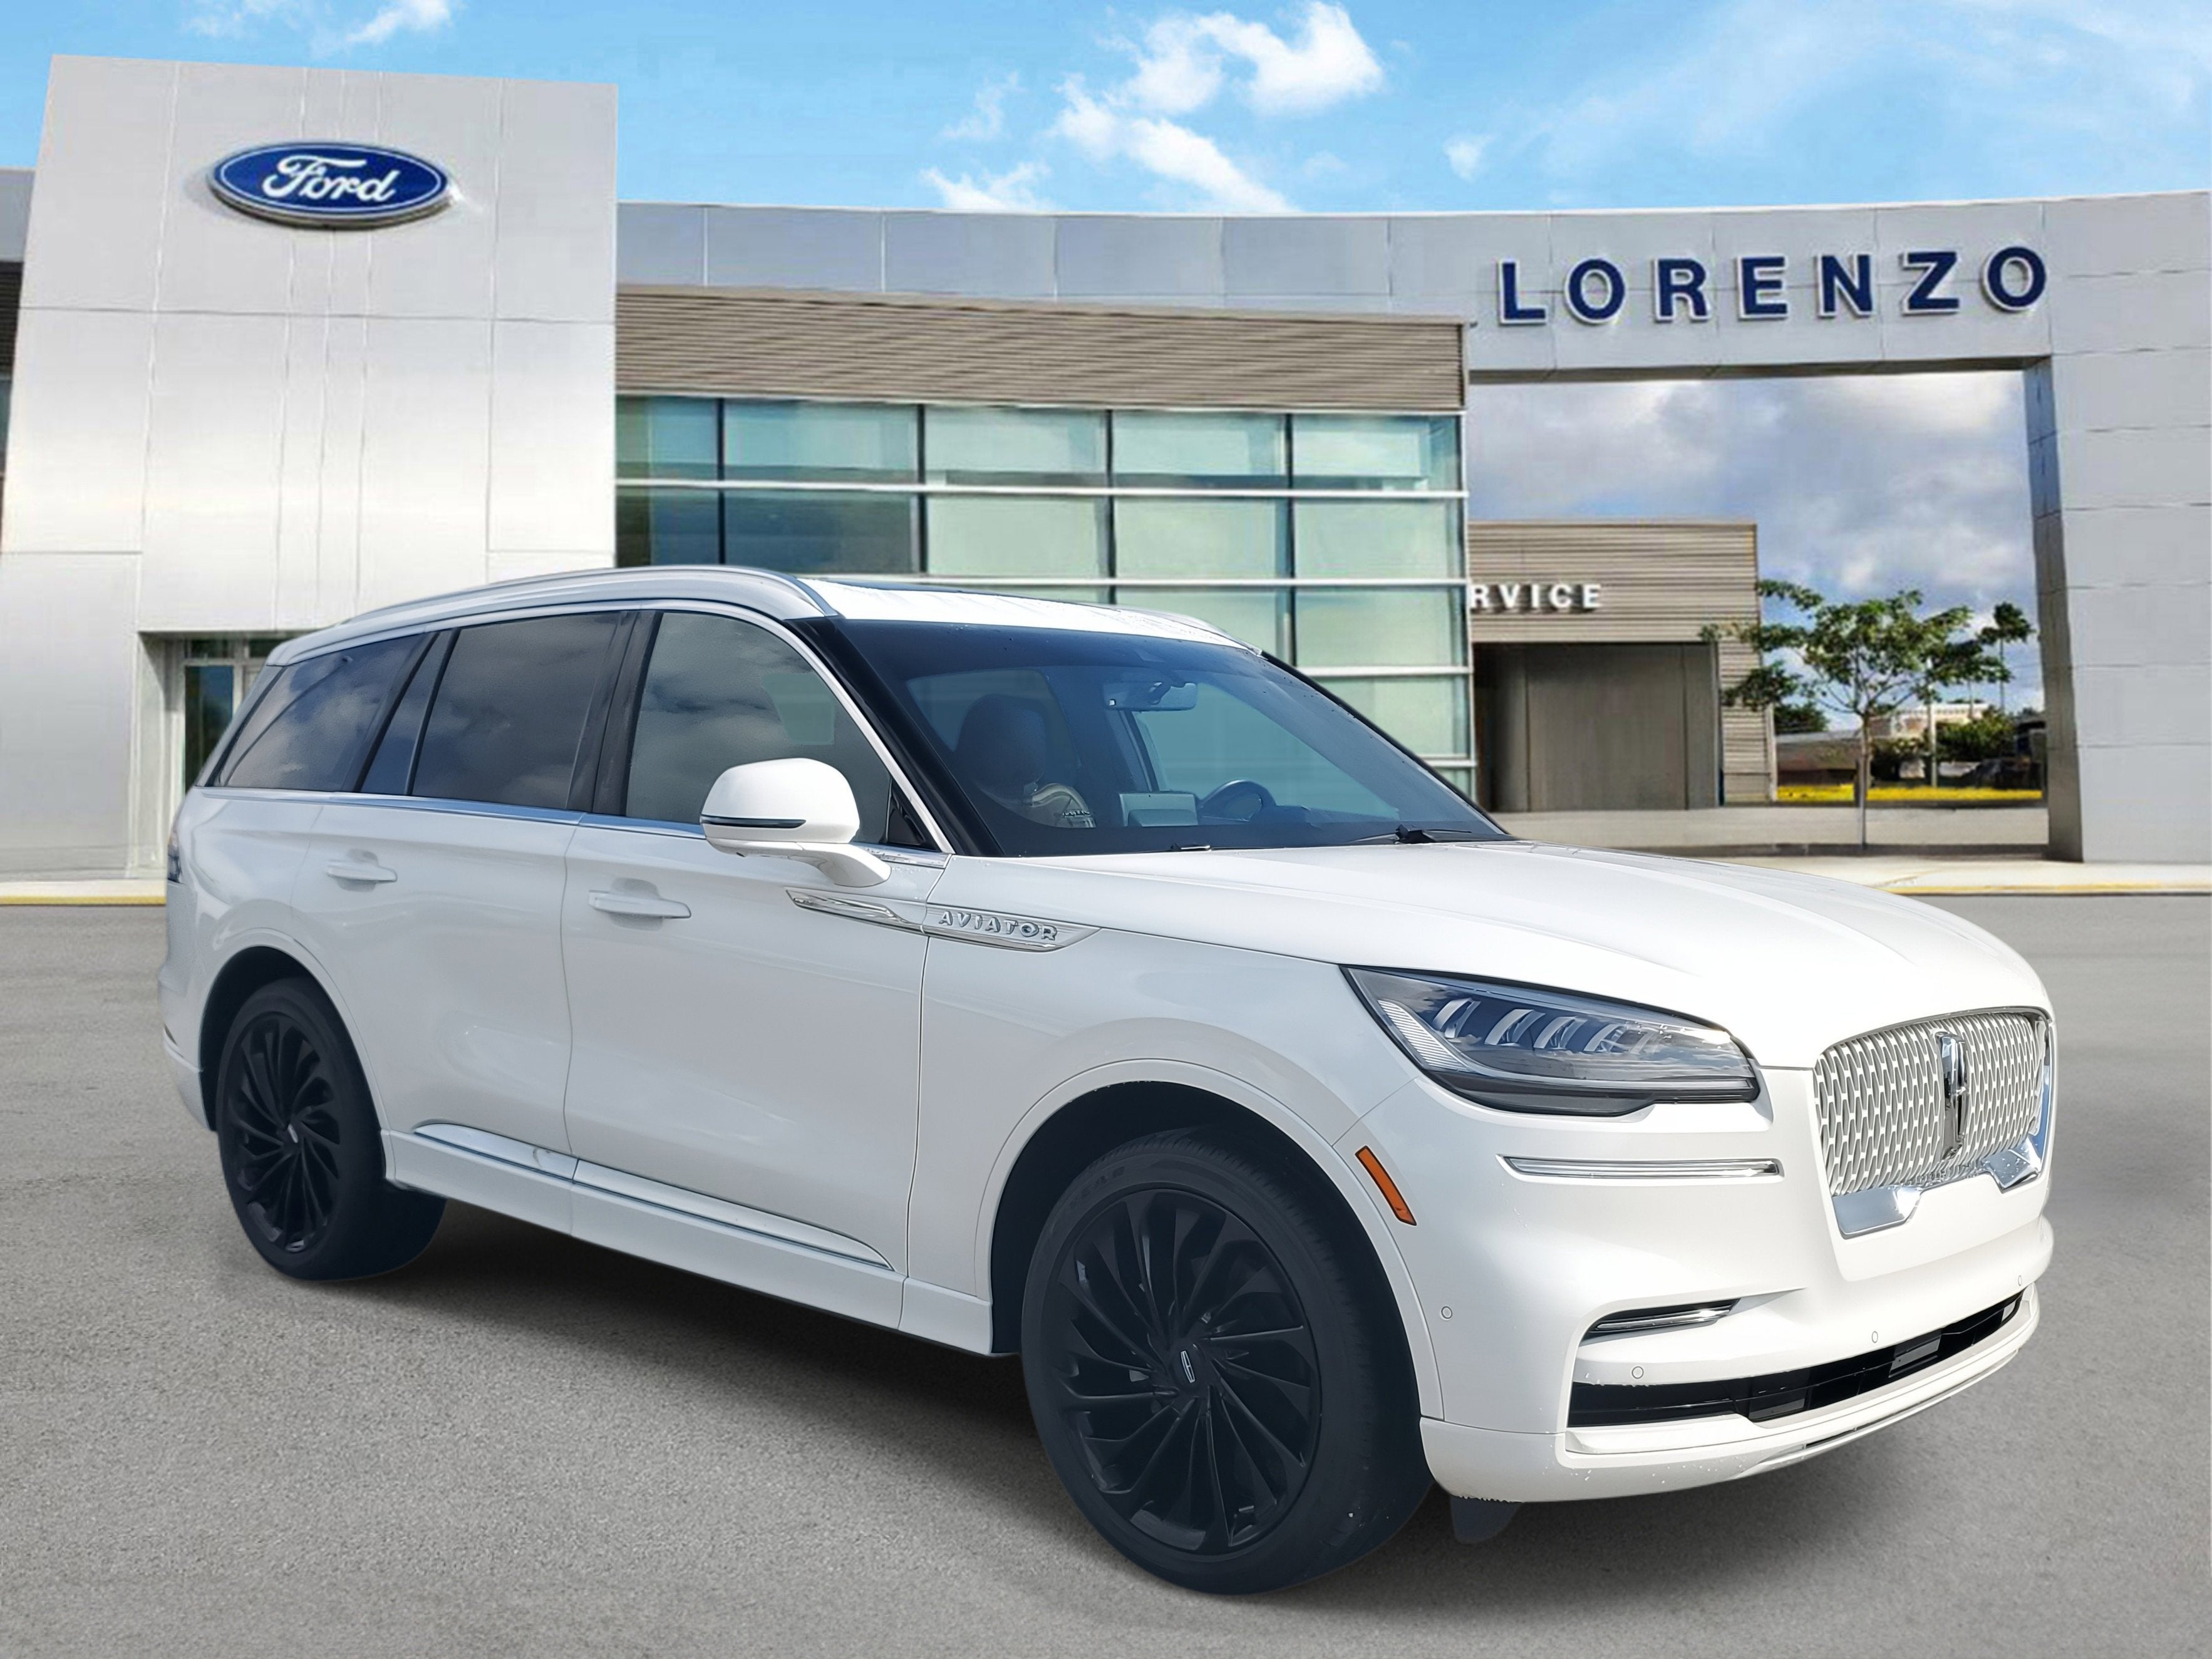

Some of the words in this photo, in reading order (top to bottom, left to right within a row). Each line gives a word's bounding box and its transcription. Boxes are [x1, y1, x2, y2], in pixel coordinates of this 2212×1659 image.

[262, 154, 401, 202] Ford
[1498, 246, 2047, 324] LORENZO
[1470, 583, 1602, 609] RVICE
[938, 910, 1058, 941] AVIATOR
